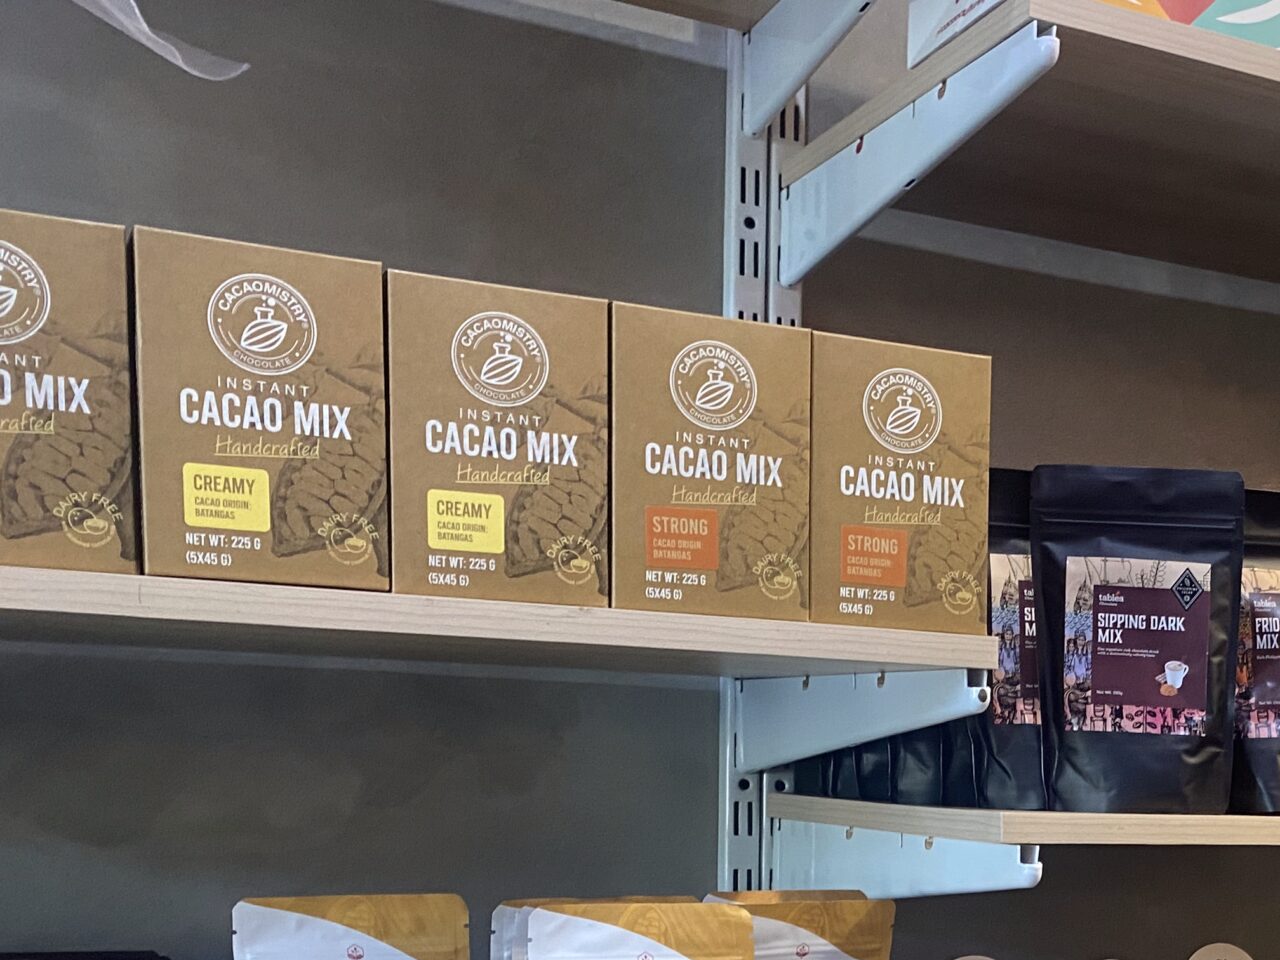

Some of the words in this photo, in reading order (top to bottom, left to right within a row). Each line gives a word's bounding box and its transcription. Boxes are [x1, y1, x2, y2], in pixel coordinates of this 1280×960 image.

[218, 281, 309, 323] CACAOMISTRY
[461, 319, 541, 358] CACAOMISTRY
[234, 350, 292, 369] CHOCOLATE
[678, 347, 750, 384] CACAOMISTRY
[25, 372, 91, 414] MIX
[217, 376, 310, 397] INSTANT
[474, 383, 526, 400] CHOCOLATE
[179, 387, 283, 432] CACAO
[294, 400, 352, 440] MIX
[459, 407, 541, 427] INSTANT
[214, 434, 320, 459] Handcrafted
[425, 419, 517, 460] CACAO
[527, 430, 578, 467] MIX
[675, 431, 750, 450] INSTANT
[645, 442, 728, 481] CACAO
[736, 452, 783, 487] MIX
[868, 455, 936, 472] INSTANT
[455, 463, 550, 485] Handcrafted
[193, 474, 256, 495] CREAMY
[840, 465, 915, 502] CACAO
[923, 474, 965, 508] MIX
[194, 497, 220, 507] CACAO
[670, 484, 757, 506] Handcrafted
[53, 491, 88, 517] DAIRY
[92, 493, 124, 522] FREE
[195, 508, 235, 520] BATANGAS
[436, 500, 492, 519] CREAMY
[317, 512, 348, 537] DAIRY
[351, 514, 380, 541] FREE
[652, 516, 708, 535] STRONG
[185, 532, 206, 546] NET
[208, 534, 229, 547] WT:
[231, 536, 251, 549] 225
[253, 537, 261, 550] G
[437, 532, 473, 543] BATANGAS
[847, 534, 898, 554] STRONG
[546, 535, 575, 559] DAIRY
[577, 536, 602, 562] FREE
[221, 553, 232, 567] G)
[428, 554, 446, 567] NET
[449, 556, 467, 569] WT:
[469, 557, 487, 570] 225
[489, 559, 496, 571] G
[1097, 613, 1146, 630] SIPPING
[1150, 615, 1185, 632] DARK
[1097, 628, 1123, 644] MIX
[1256, 634, 1280, 649] MIX
